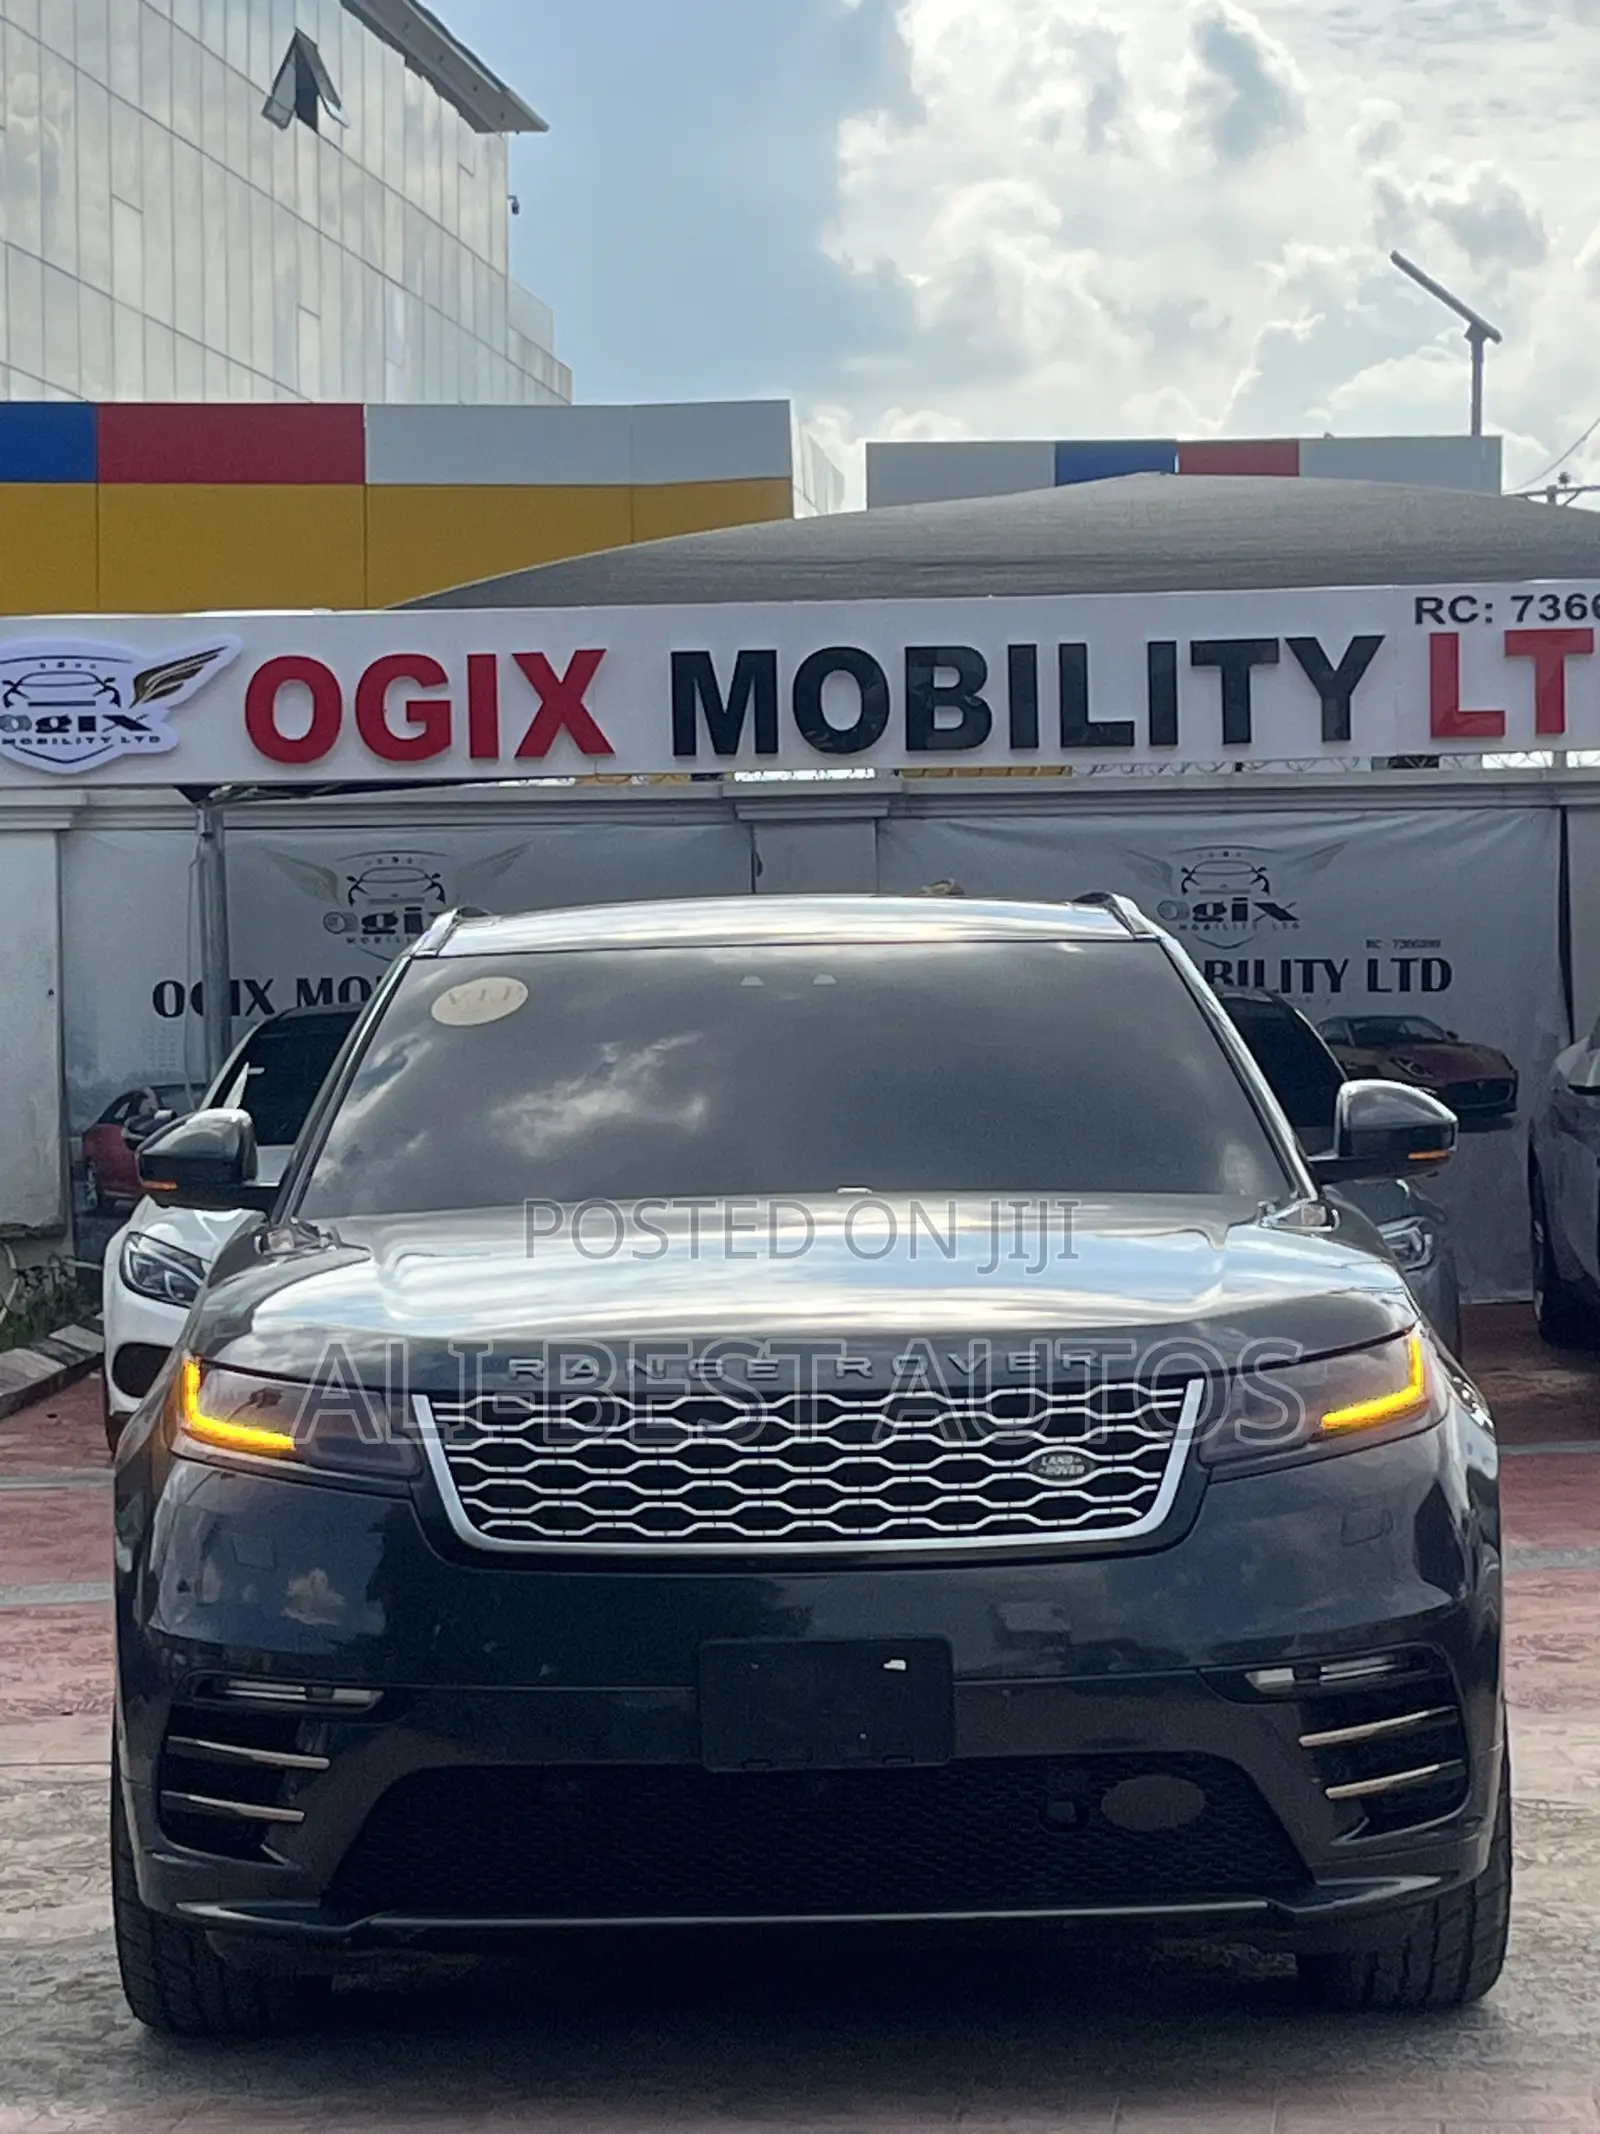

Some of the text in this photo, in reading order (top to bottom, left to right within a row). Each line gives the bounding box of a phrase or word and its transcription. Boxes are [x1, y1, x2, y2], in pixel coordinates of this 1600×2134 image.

[1414, 594, 1493, 625] RC:
[244, 628, 1595, 765] OGIX MOBILITY LT
[1367, 957, 1453, 993] LTD
[508, 1347, 1102, 1381] RANGE ROVER
